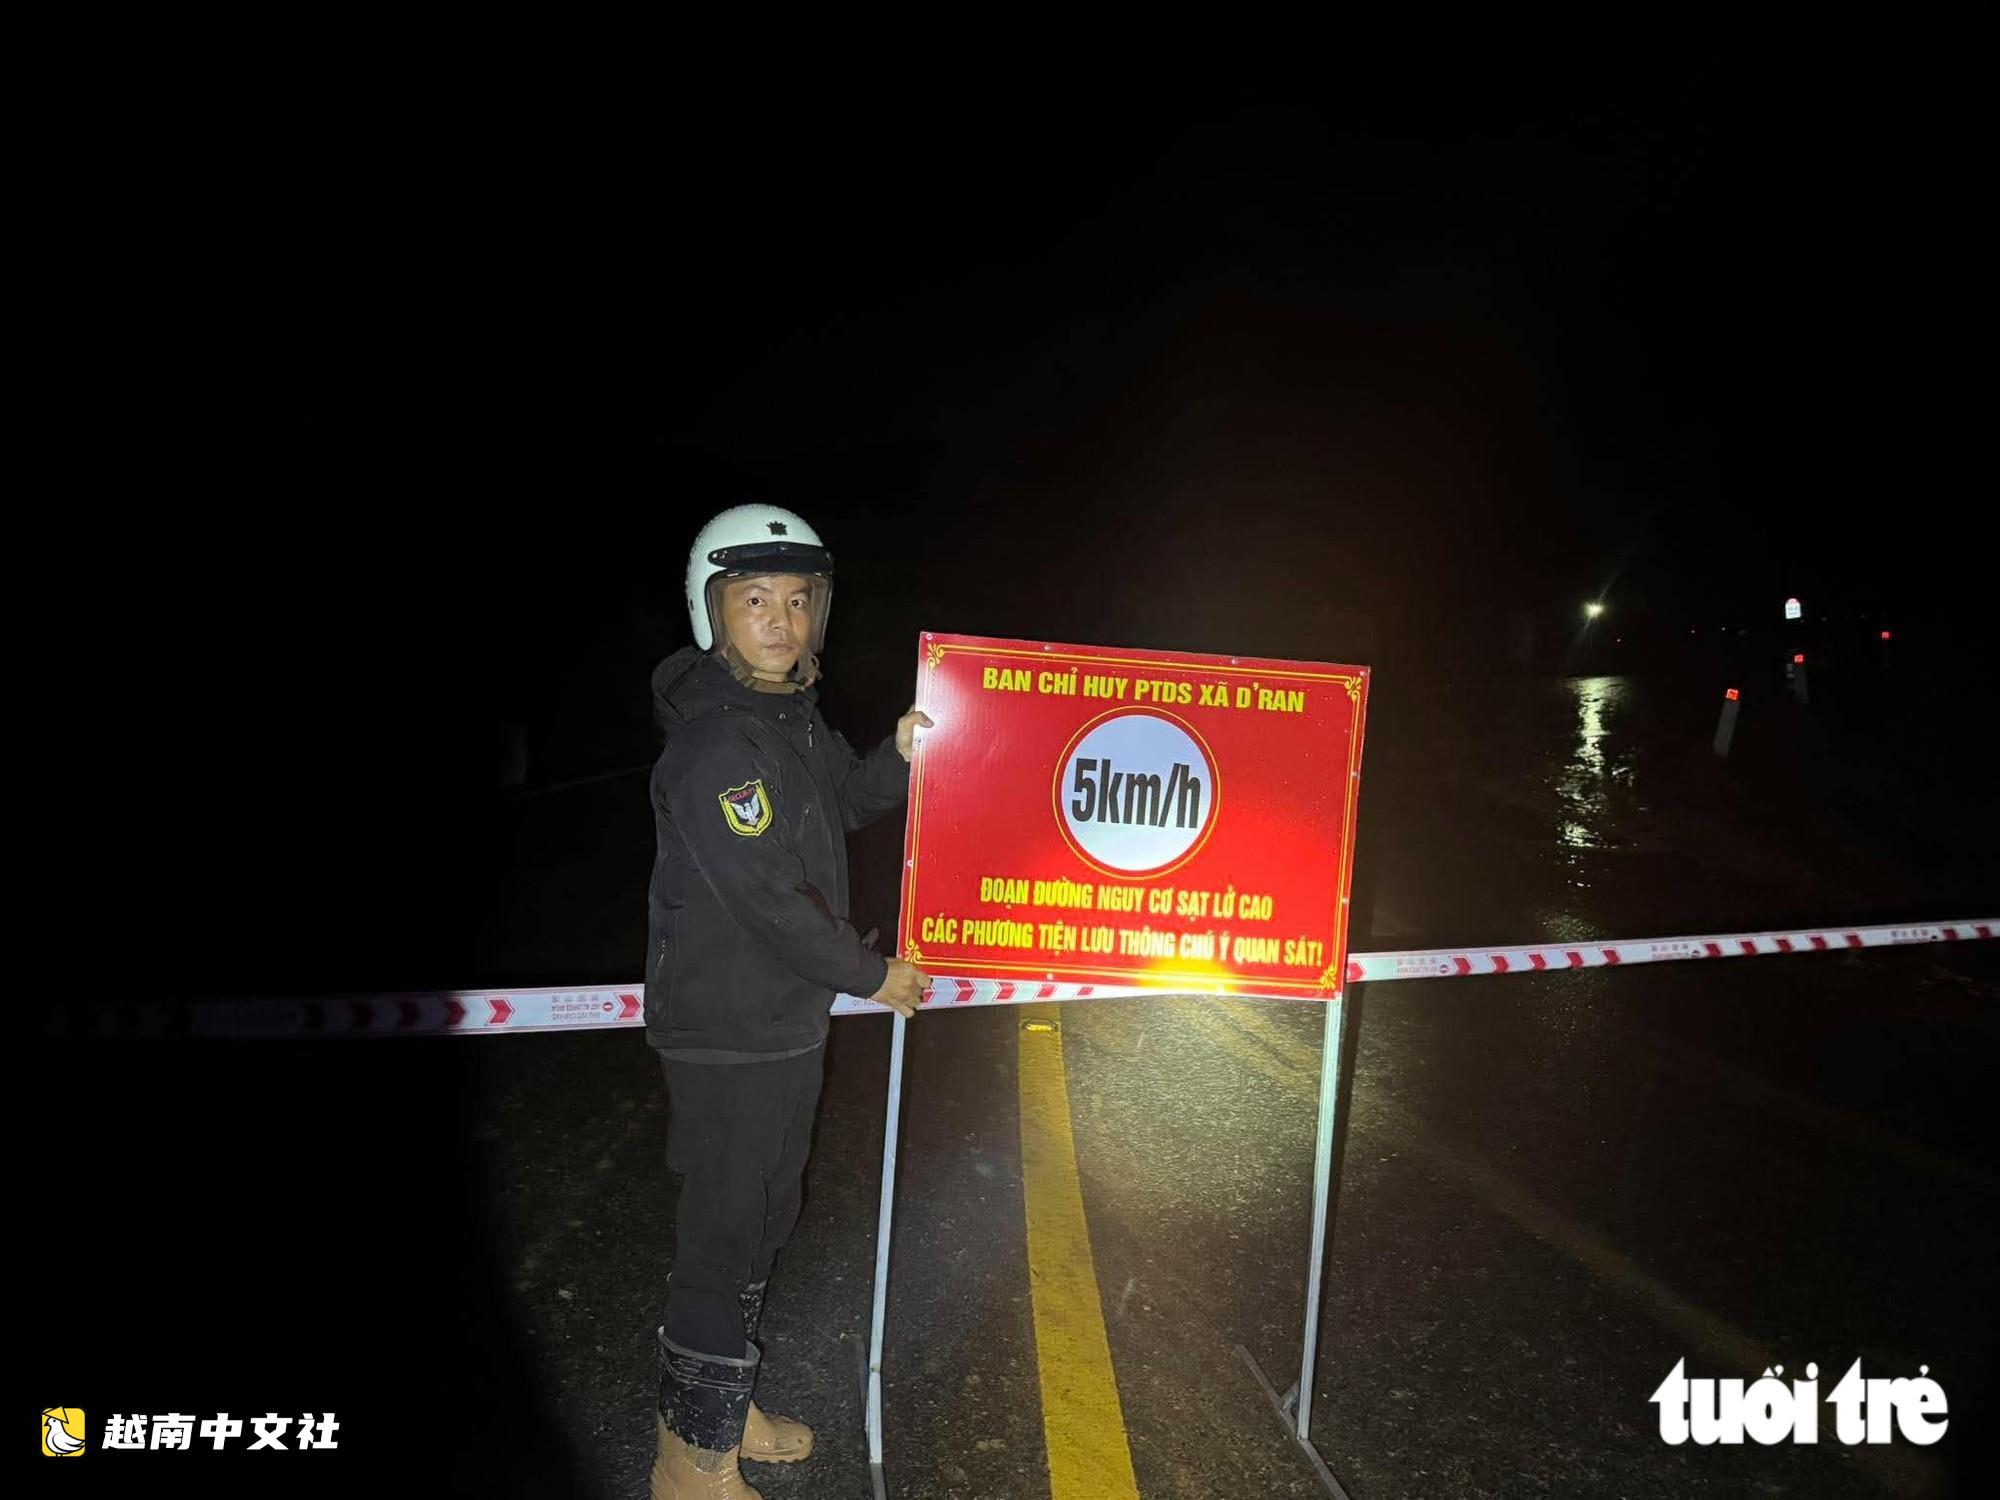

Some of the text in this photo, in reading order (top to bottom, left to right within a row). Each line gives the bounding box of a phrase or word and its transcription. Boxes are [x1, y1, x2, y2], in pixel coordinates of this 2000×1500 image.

[982, 666, 1305, 712] BAN CHỈ HUY PTDS XÃ D'RAN
[1071, 757, 1202, 829] 5km/h
[979, 876, 1274, 922] ĐOẠN ĐƯỜNG NGUY CƠ SẠT LỞ CAO
[921, 912, 1324, 967] CÁC PHƯƠNG TIỆN LƯU THÔNG CHÚ Ý QUAN SÁT!
